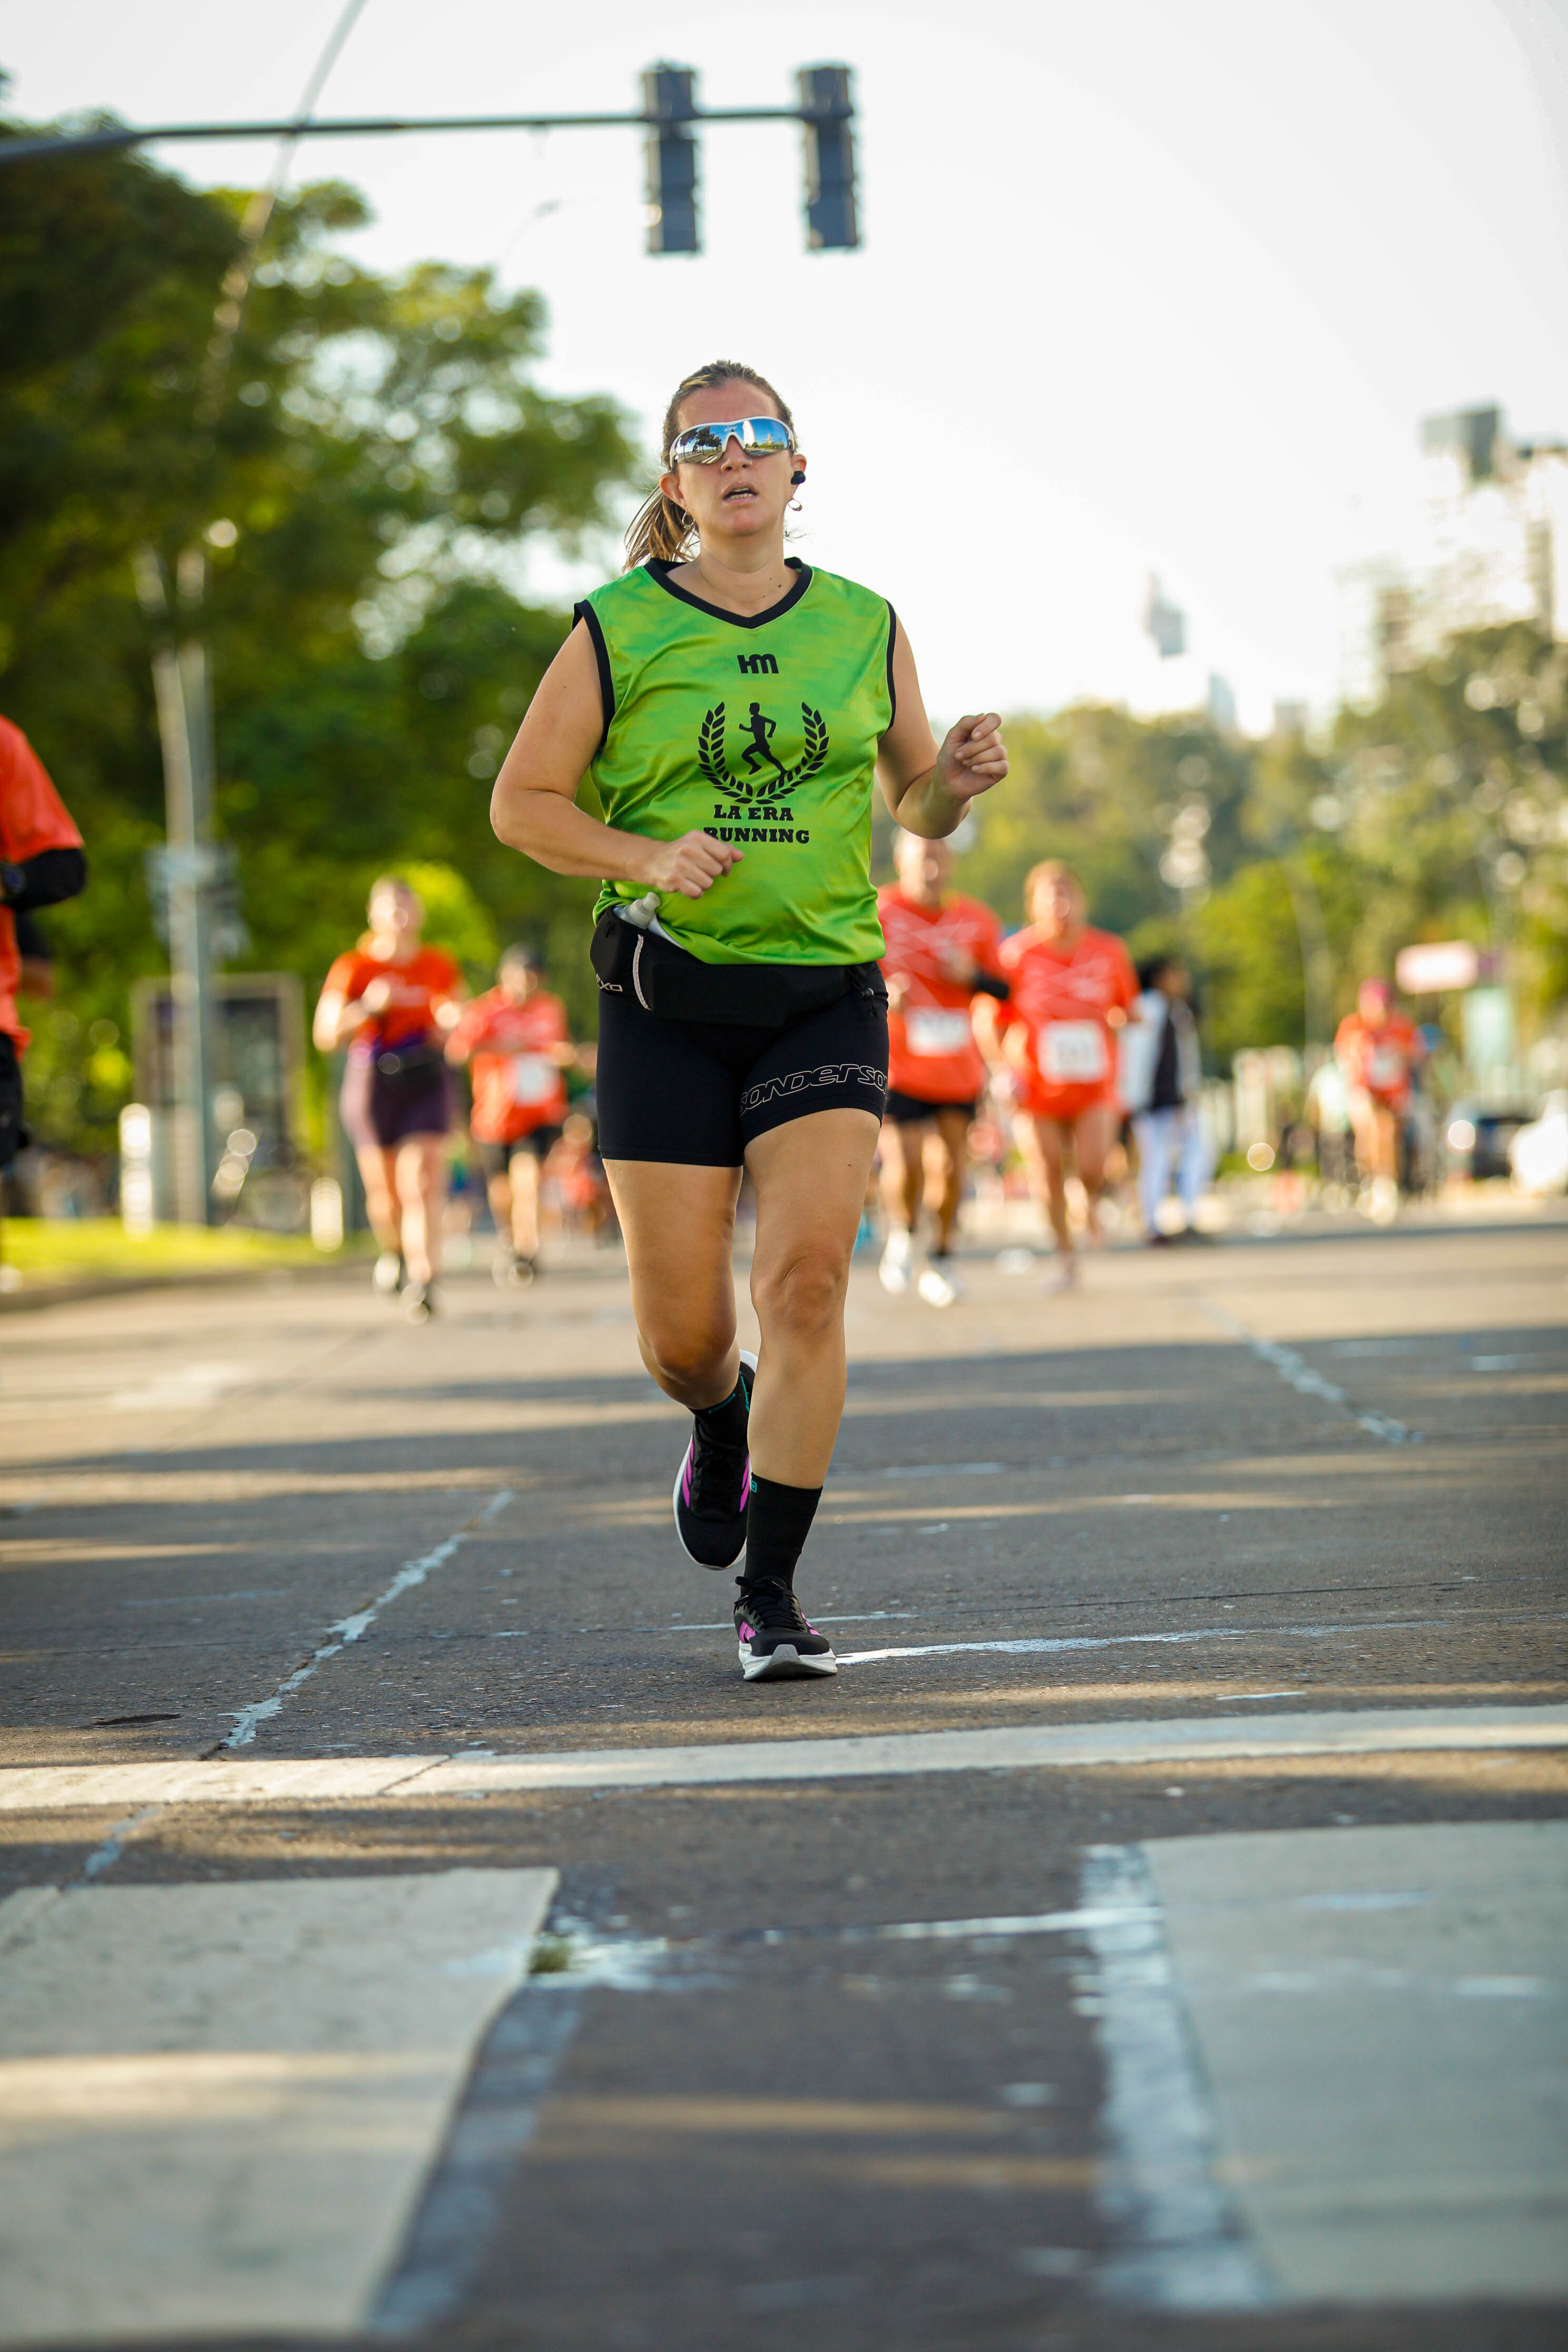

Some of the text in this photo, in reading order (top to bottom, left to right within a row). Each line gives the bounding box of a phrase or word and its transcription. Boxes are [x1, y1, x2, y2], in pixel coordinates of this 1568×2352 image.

[713, 805, 794, 821] LA ERA
[703, 827, 810, 844] RUNNING
